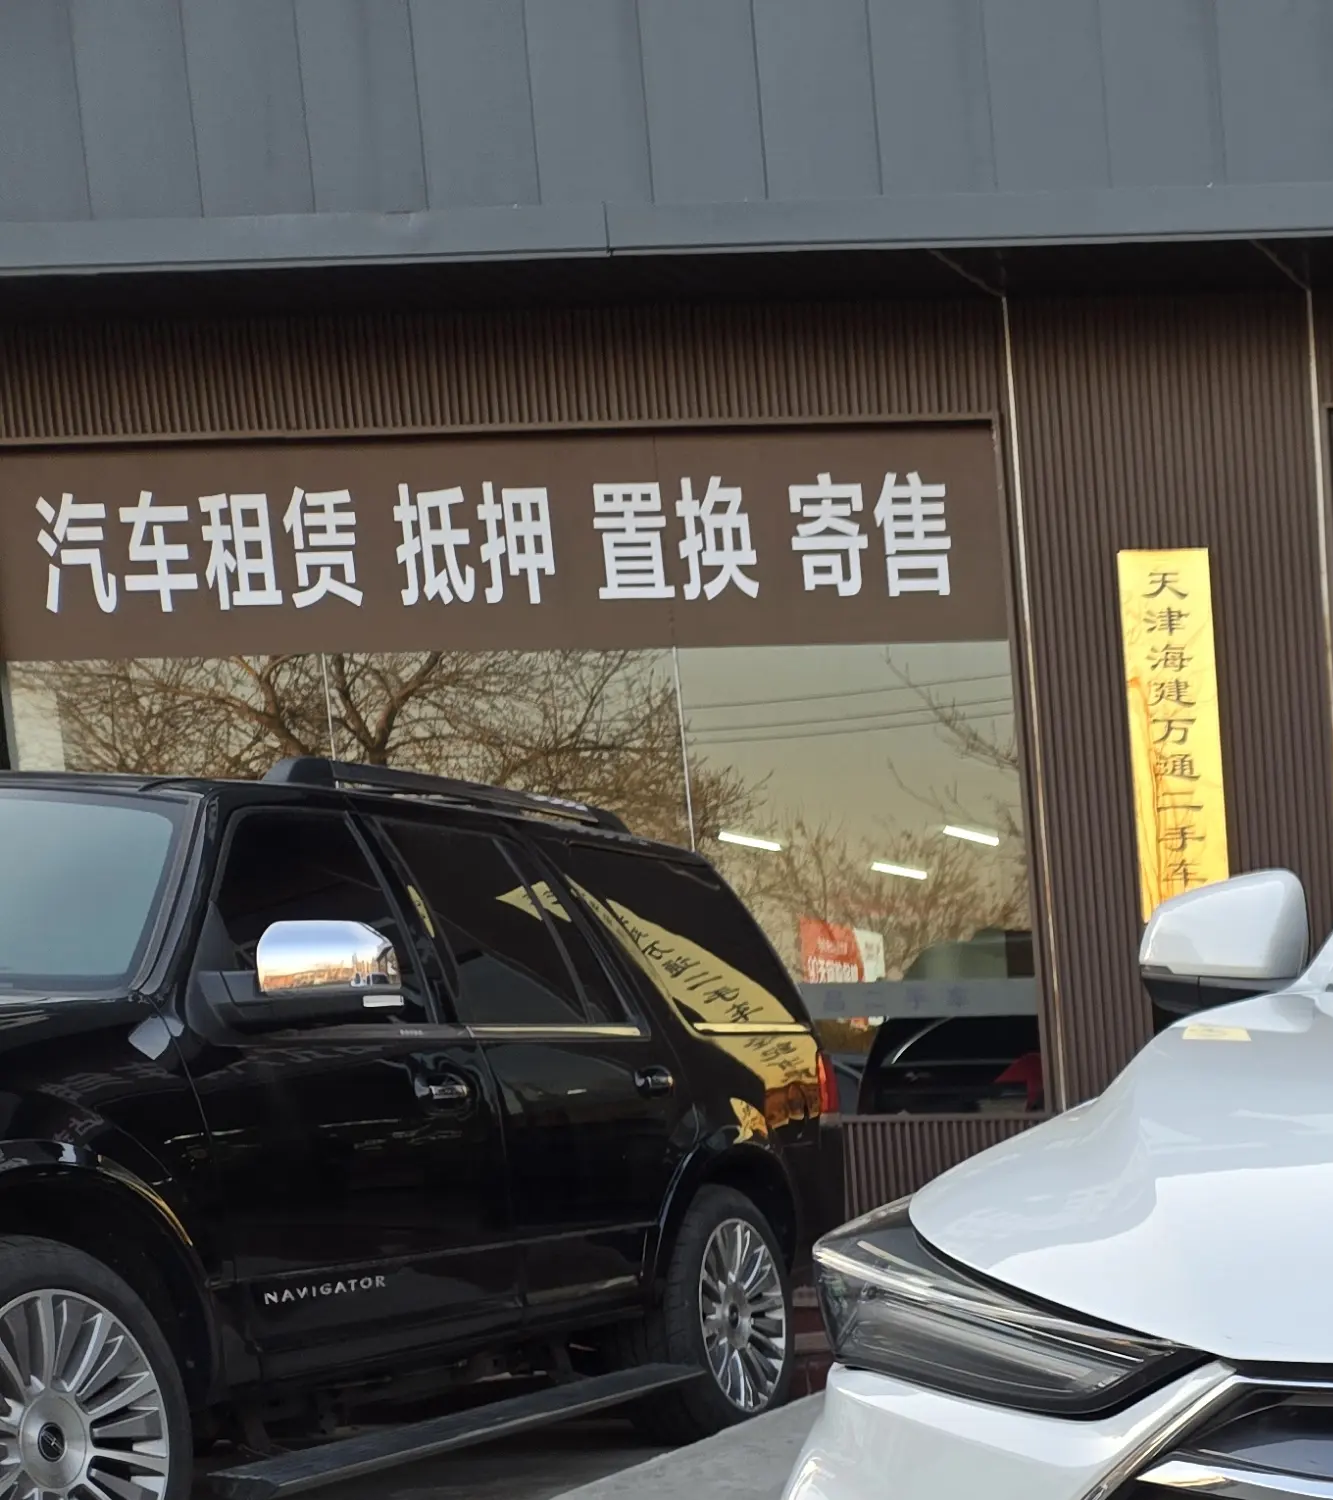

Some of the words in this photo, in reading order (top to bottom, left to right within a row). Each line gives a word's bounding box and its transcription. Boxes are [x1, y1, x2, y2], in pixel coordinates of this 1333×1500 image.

[34, 486, 364, 614] 汽车租赁
[391, 480, 557, 606] 抵押
[591, 474, 760, 601] 置换
[787, 470, 953, 597] 寄售
[1142, 570, 1208, 888] 天津海建万通二手车
[263, 1275, 386, 1305] NAVIGATOR
